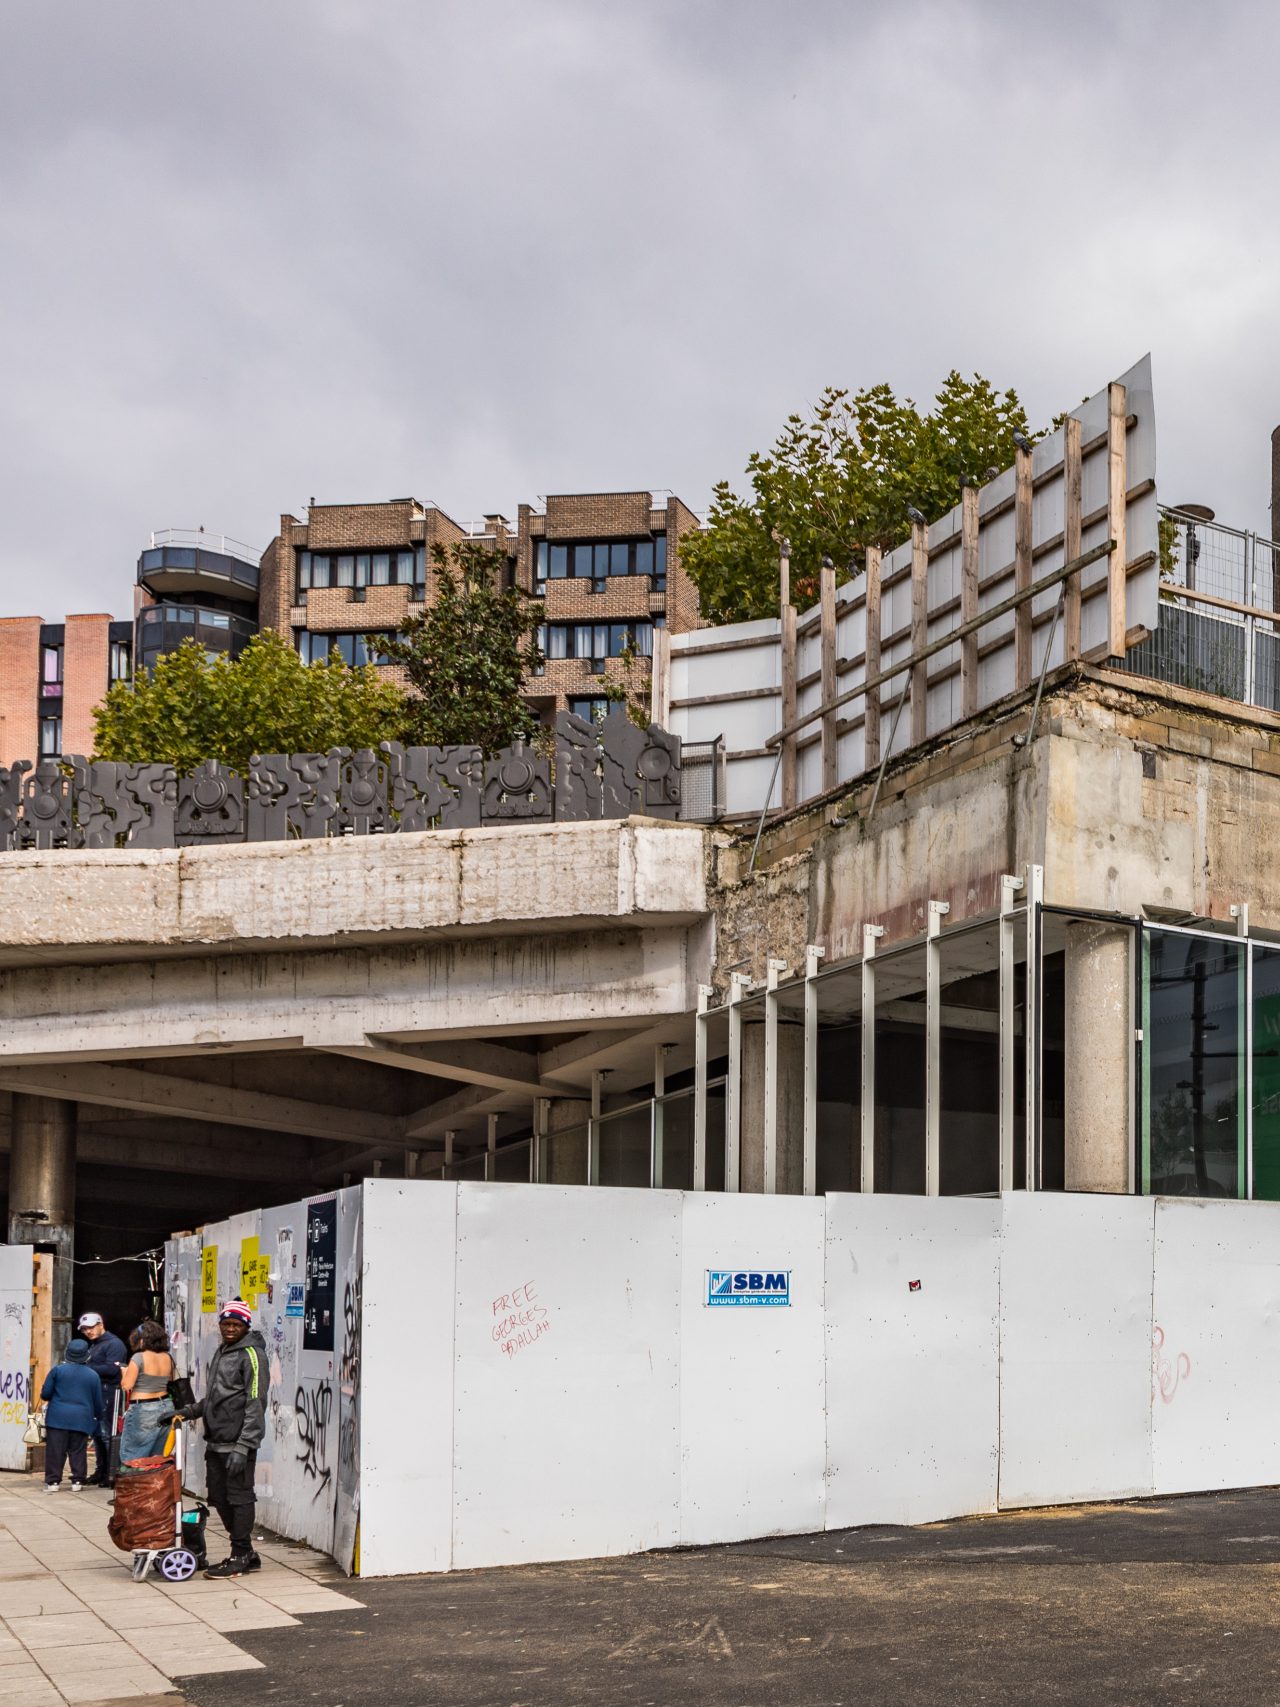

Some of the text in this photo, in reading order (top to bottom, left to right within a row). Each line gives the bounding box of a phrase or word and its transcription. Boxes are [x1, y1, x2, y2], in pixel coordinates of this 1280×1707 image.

[733, 1273, 786, 1290] SBM
[291, 1285, 304, 1302] SBM
[492, 1279, 538, 1316] FREE
[710, 1295, 787, 1305] www.sbm-v.com
